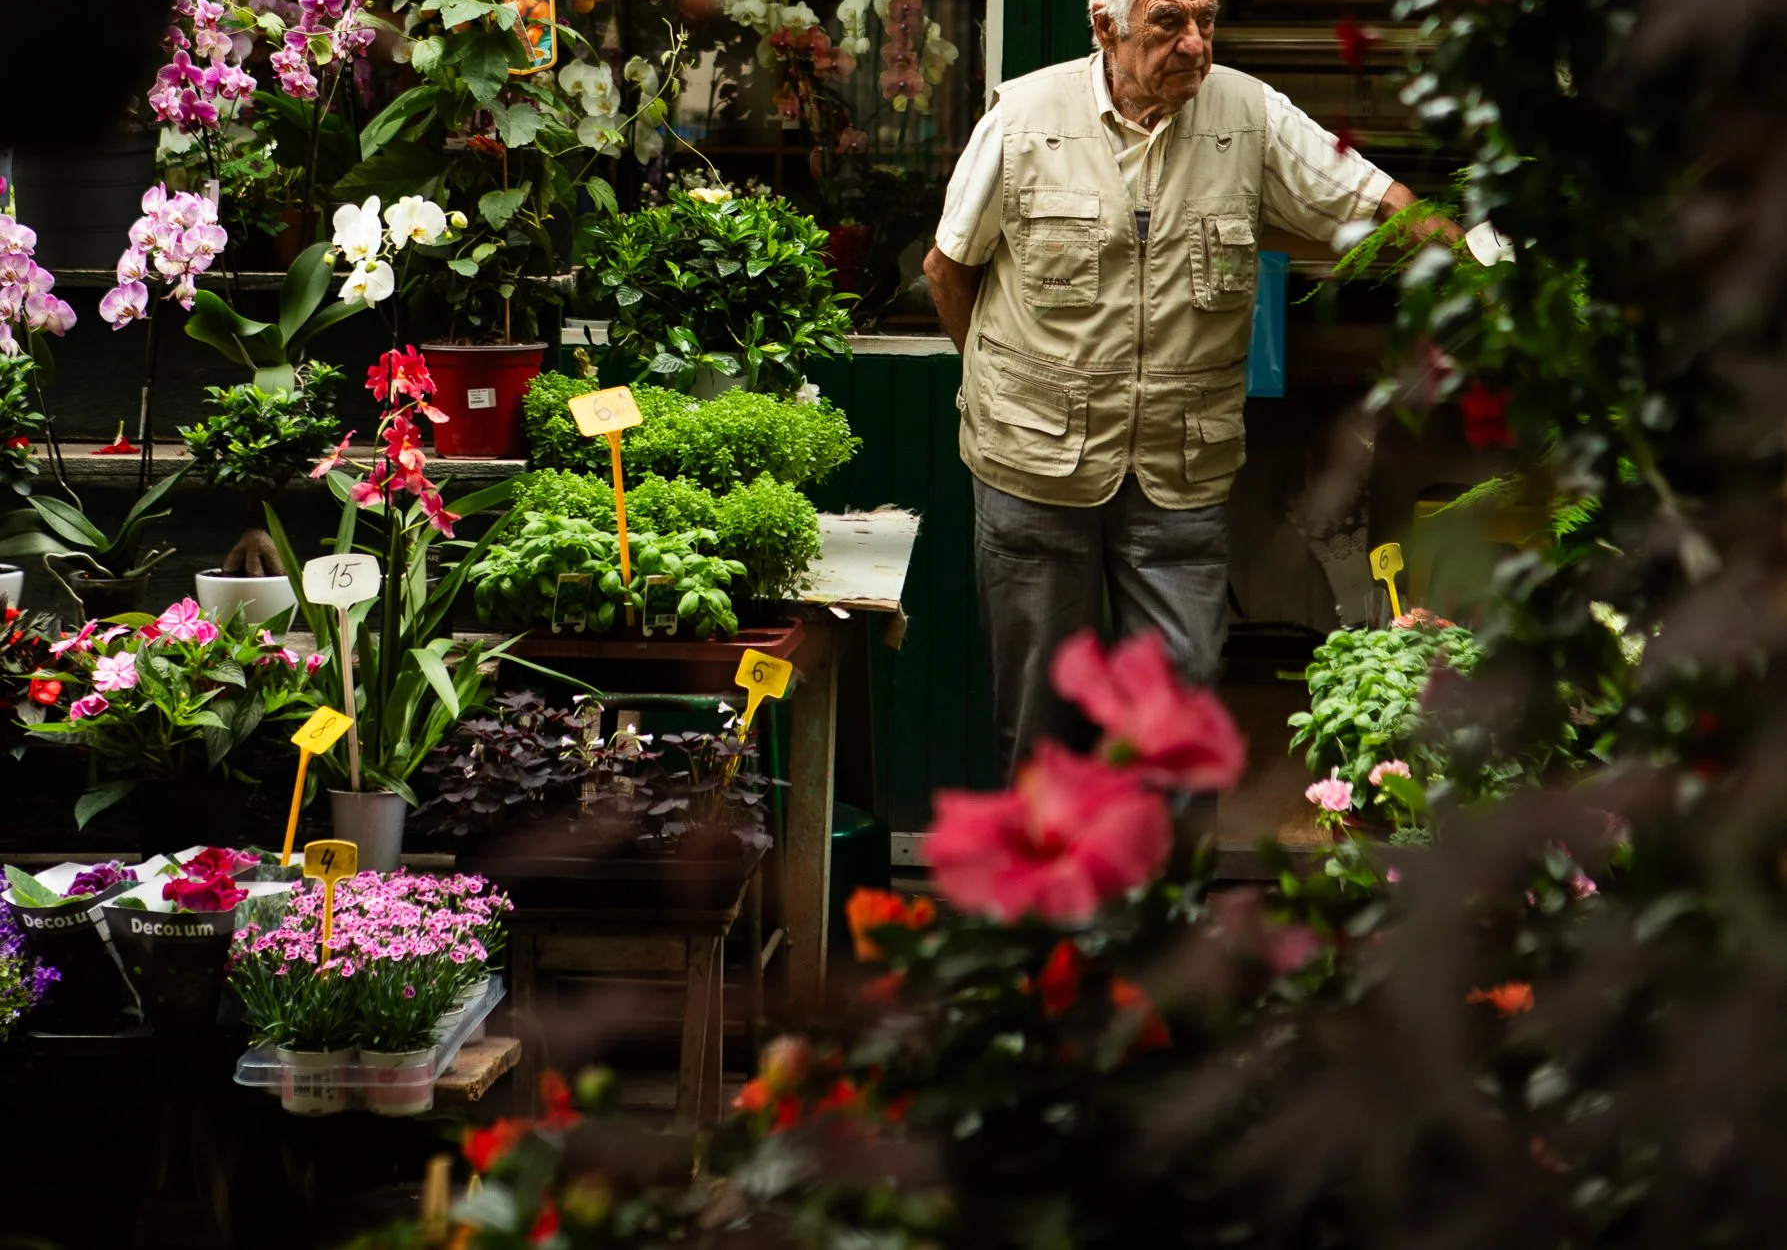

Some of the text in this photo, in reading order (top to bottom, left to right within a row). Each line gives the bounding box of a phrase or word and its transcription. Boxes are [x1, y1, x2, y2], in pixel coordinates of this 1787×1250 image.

[594, 396, 612, 421] 6
[1380, 549, 1389, 570] 6
[329, 562, 362, 590] 15
[752, 661, 770, 683] 6
[309, 716, 337, 739] 8
[320, 848, 335, 875] 4
[22, 910, 89, 929] Decoru
[131, 917, 214, 937] Decorum
